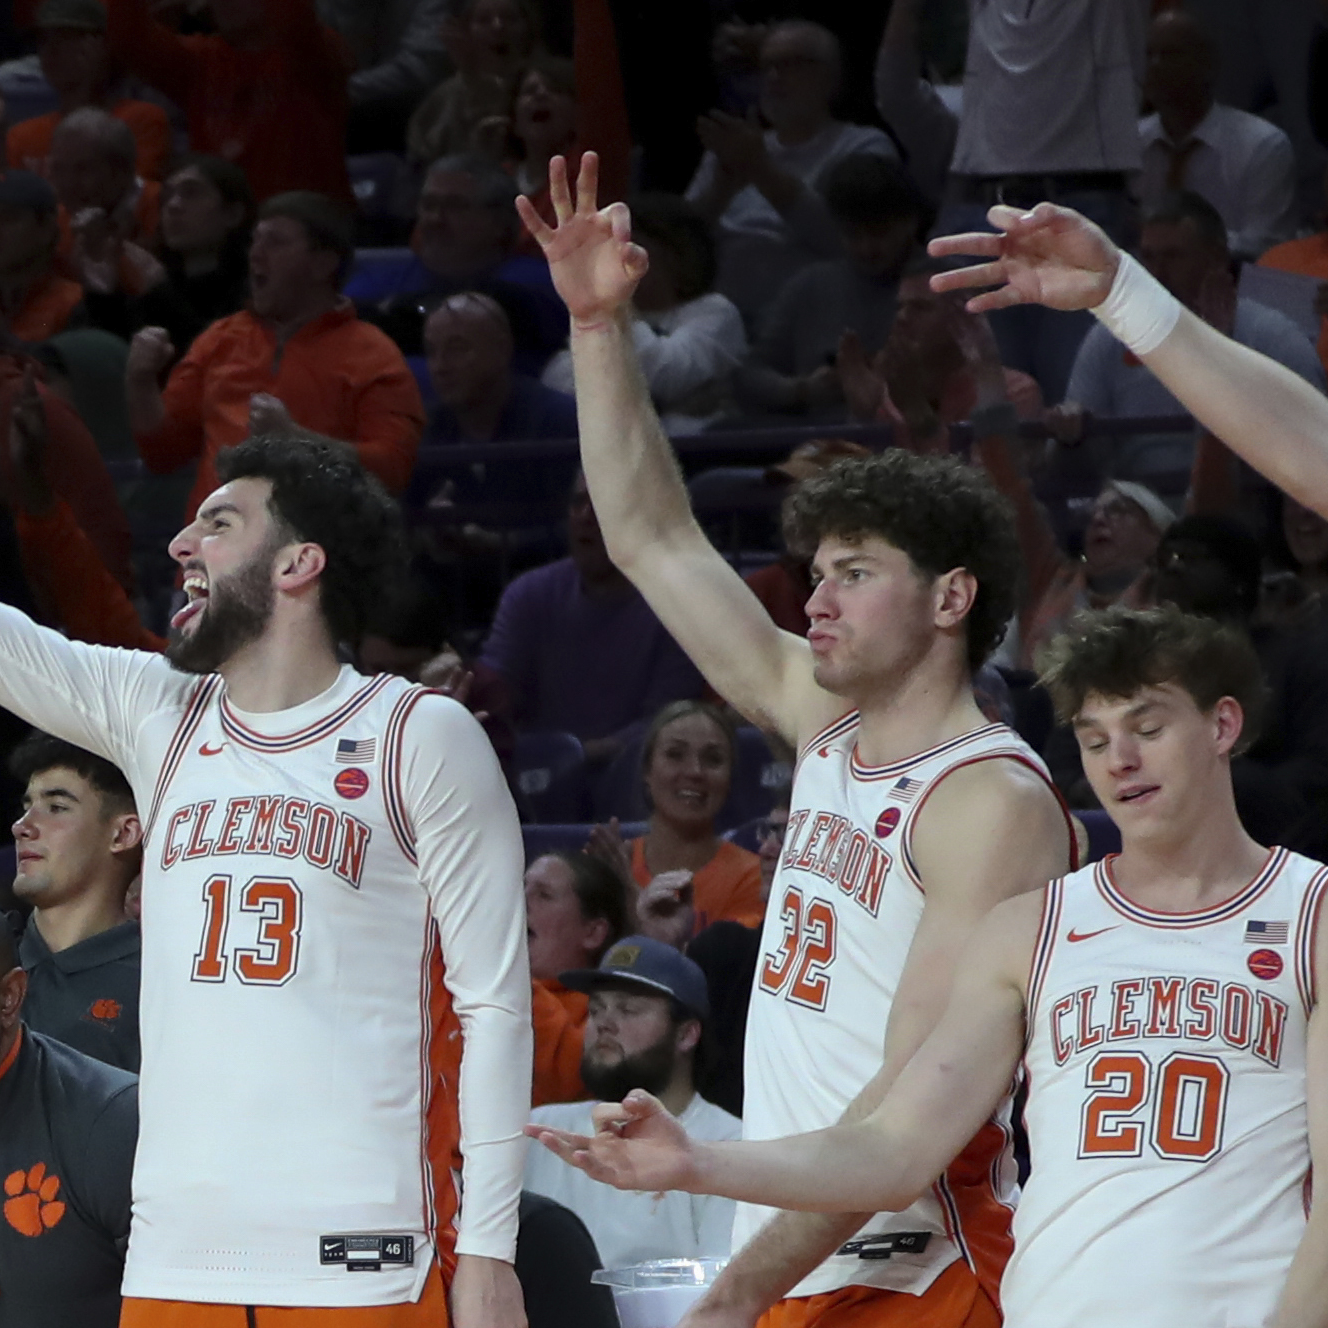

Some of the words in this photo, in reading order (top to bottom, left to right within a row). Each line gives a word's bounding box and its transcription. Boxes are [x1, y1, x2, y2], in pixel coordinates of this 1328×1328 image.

[160, 795, 372, 889] CLEMSON
[191, 874, 303, 987] 13
[759, 885, 837, 1012] 32
[1050, 976, 1289, 1069] CLEMSON
[1077, 1051, 1231, 1163] 20
[385, 1242, 402, 1255] 46
